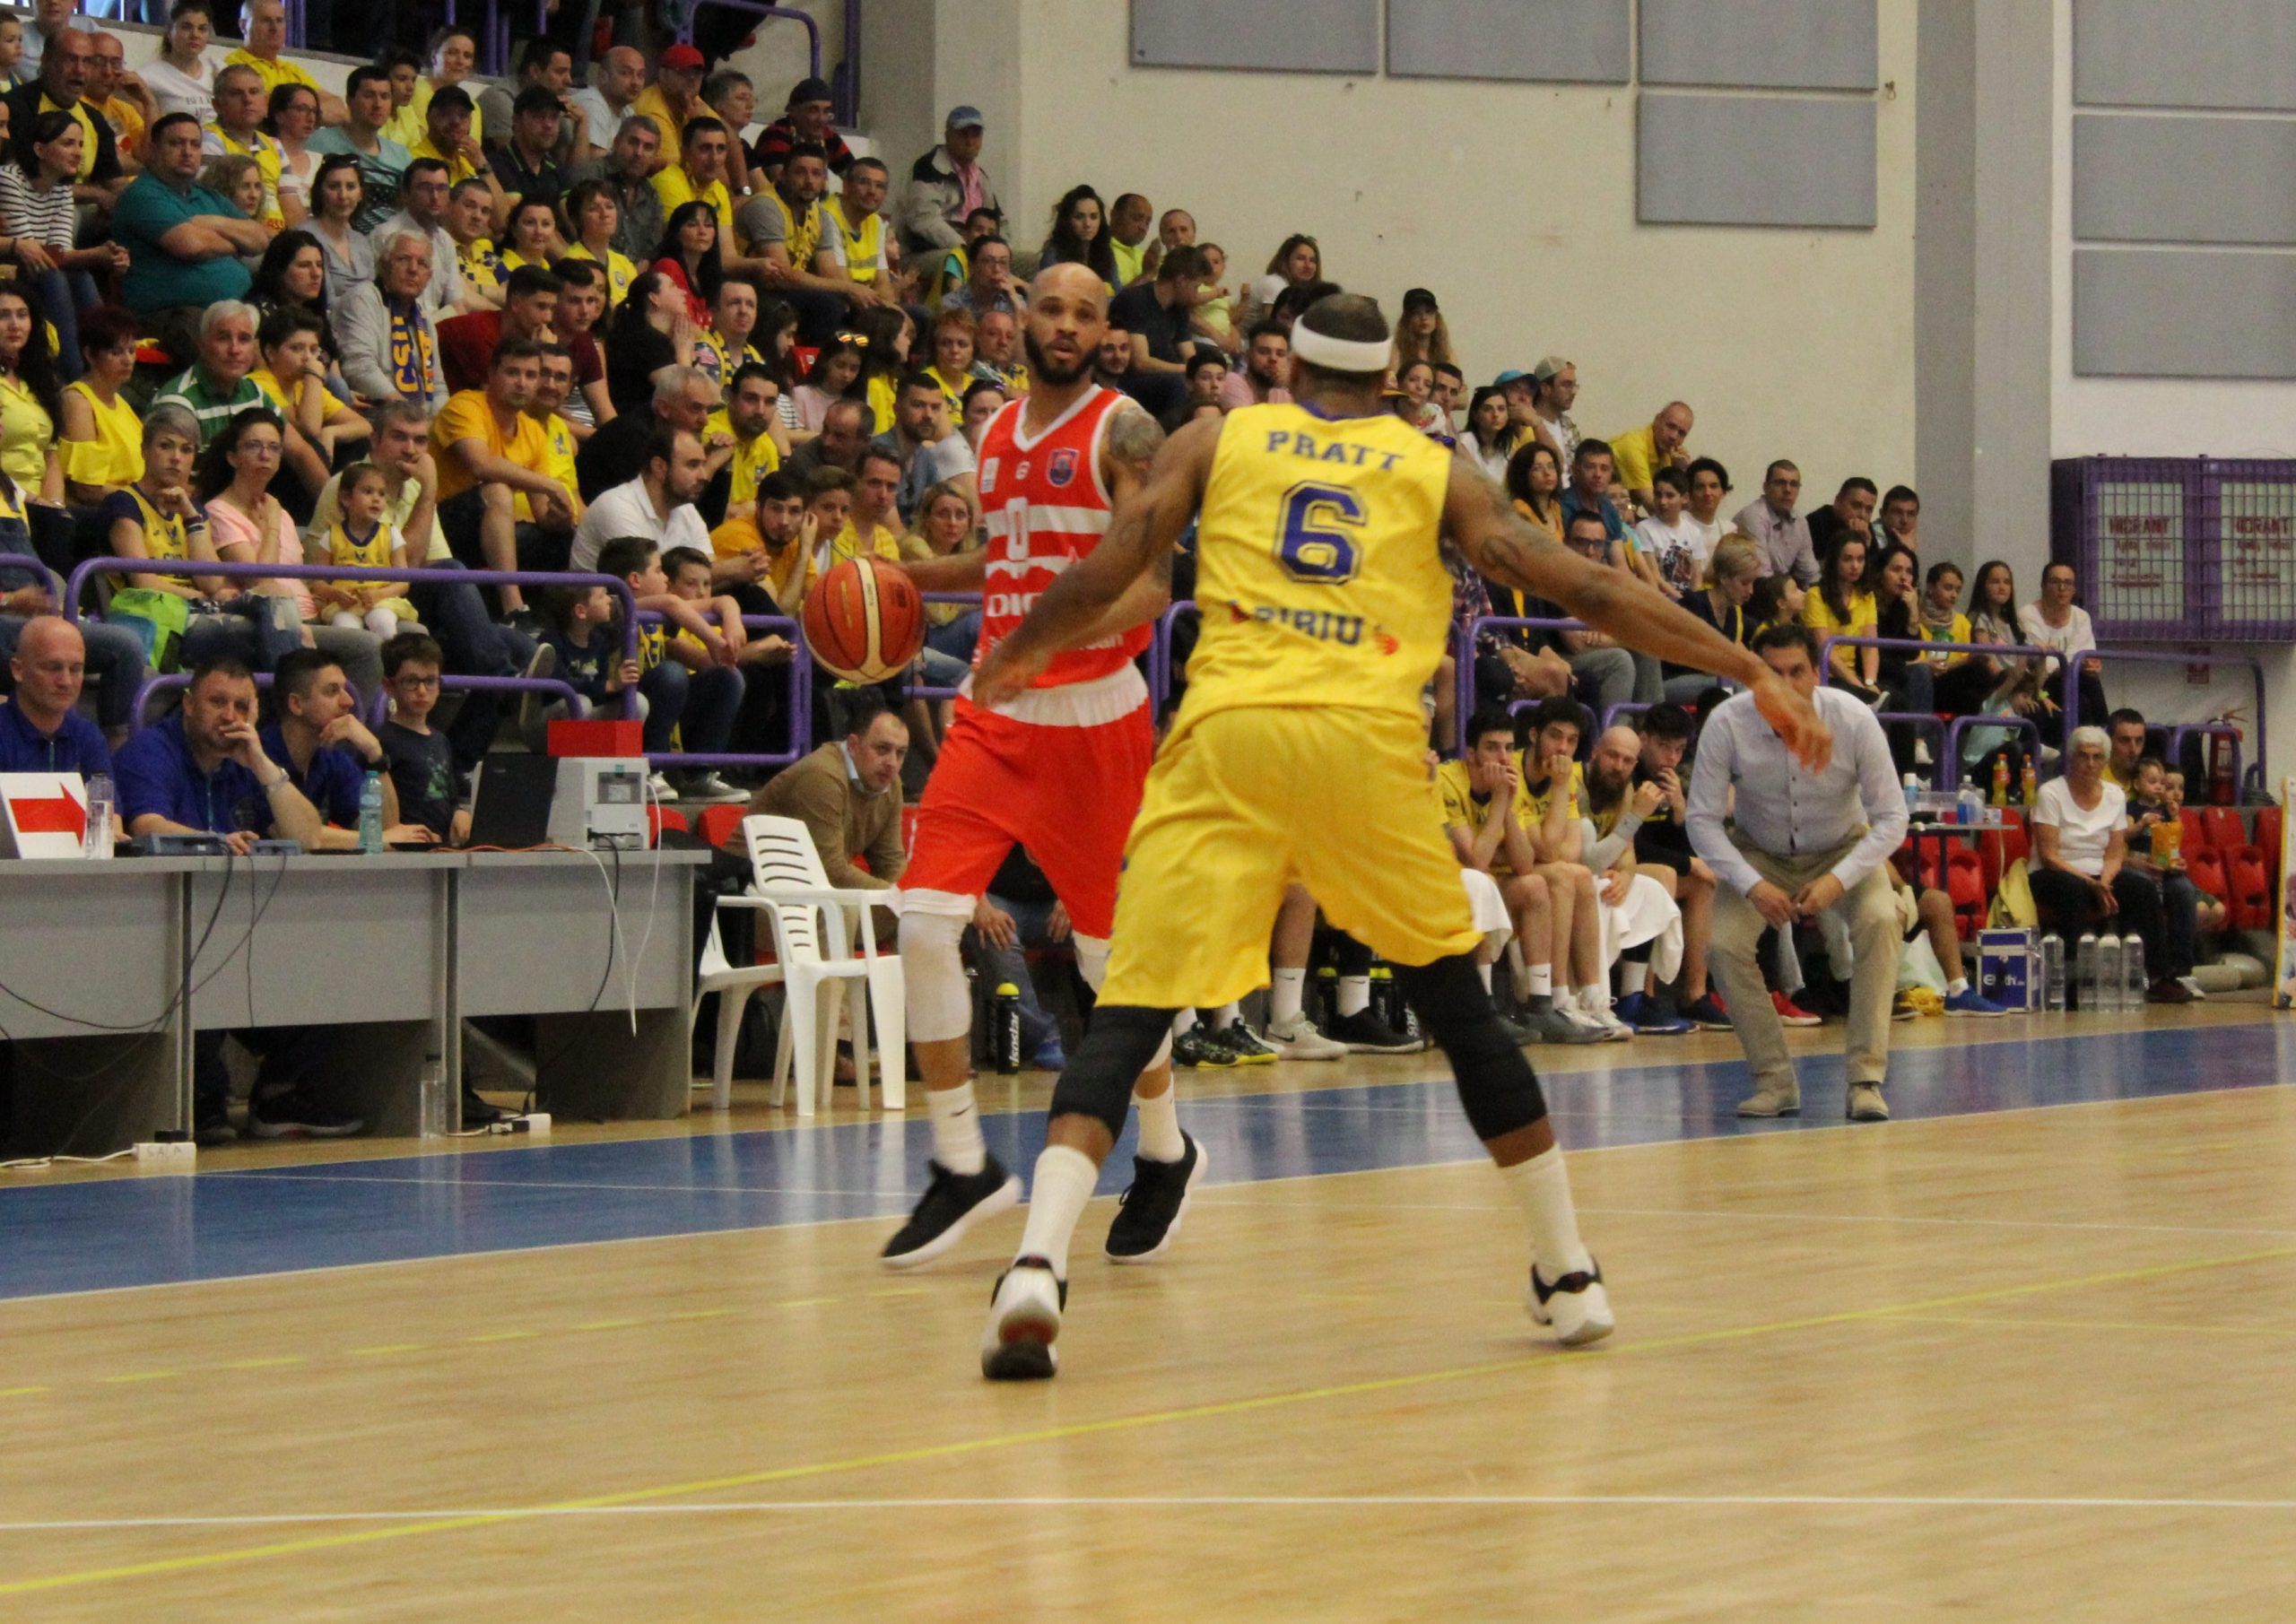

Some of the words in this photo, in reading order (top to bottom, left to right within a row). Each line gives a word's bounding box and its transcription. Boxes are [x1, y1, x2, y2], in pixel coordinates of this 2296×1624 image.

[1265, 430, 1405, 470] PRATT
[1005, 496, 1029, 561] 0
[1273, 480, 1368, 585] 6
